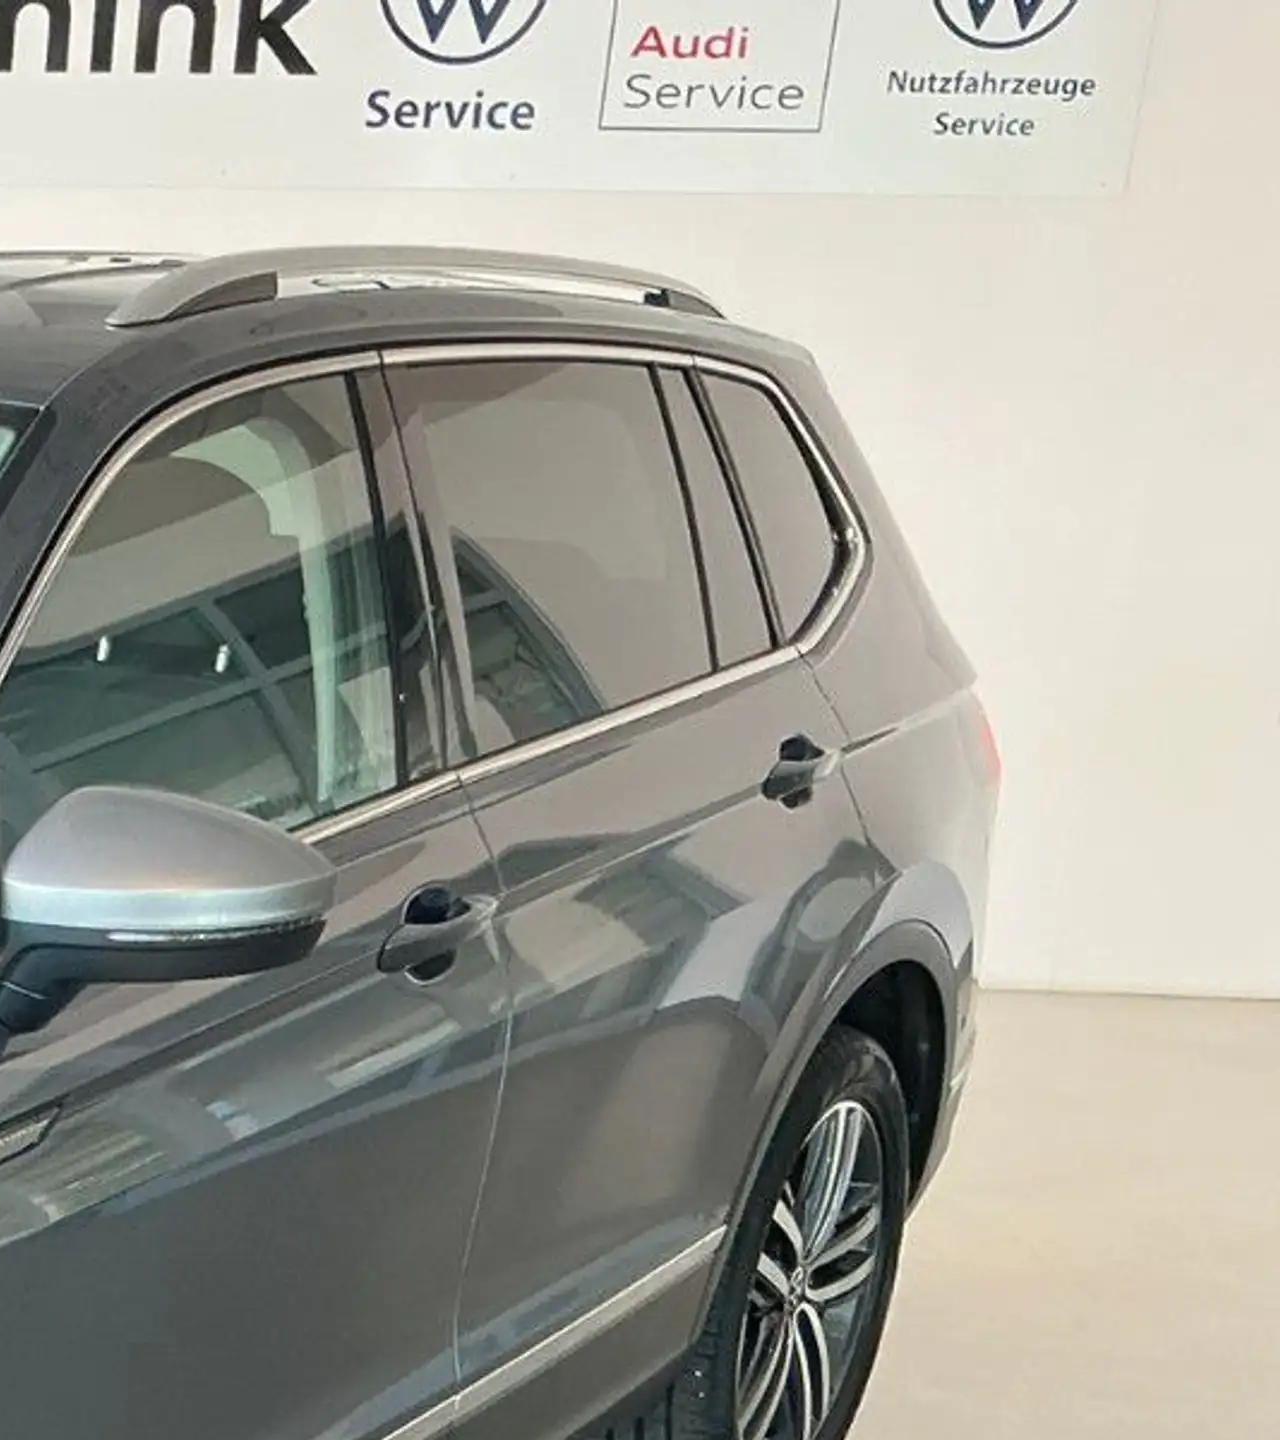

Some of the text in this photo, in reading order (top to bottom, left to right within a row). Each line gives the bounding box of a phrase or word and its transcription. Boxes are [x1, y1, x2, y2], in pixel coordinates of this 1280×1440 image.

[630, 26, 750, 59] Audi
[623, 74, 805, 111] Service
[886, 69, 1097, 102] Nutzfahrzeuge
[365, 90, 535, 130] Service
[933, 111, 1036, 136] Service
